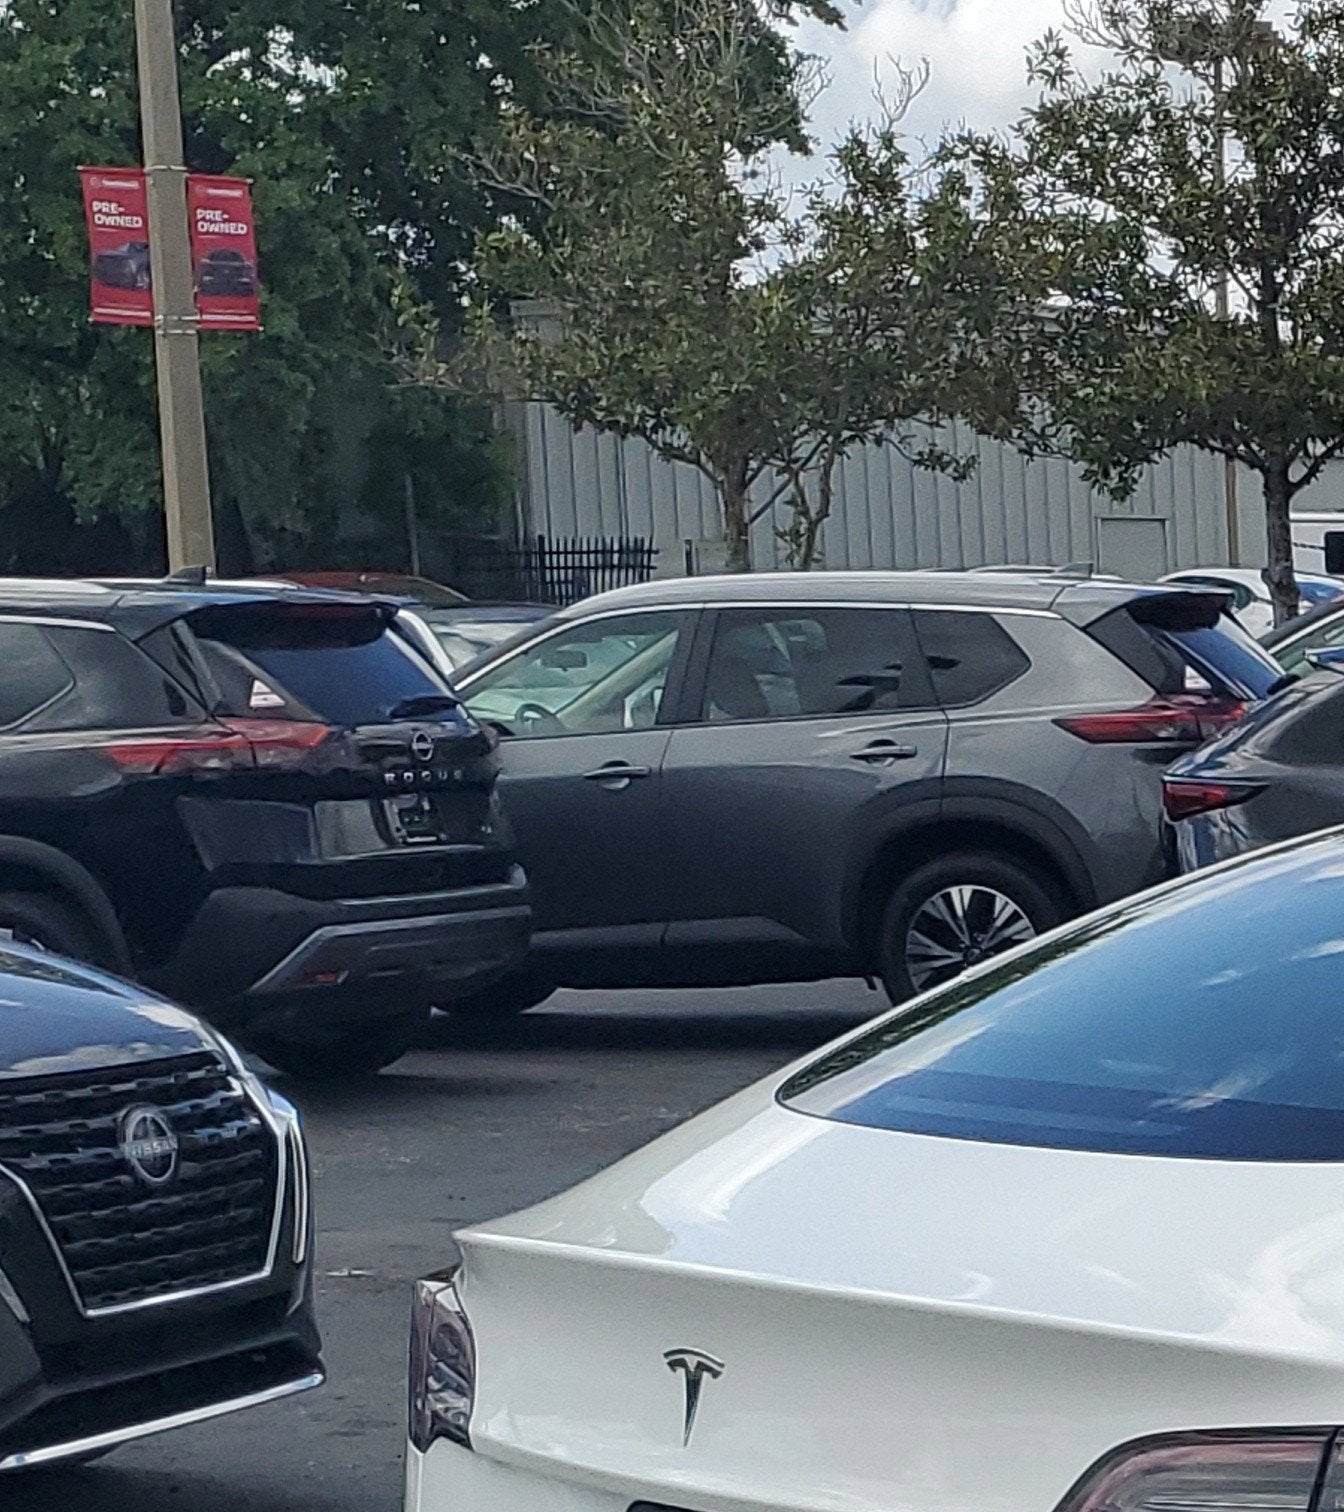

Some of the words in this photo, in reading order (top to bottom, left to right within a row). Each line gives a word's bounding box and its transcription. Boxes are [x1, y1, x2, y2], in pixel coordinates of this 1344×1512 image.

[92, 201, 126, 214] PRE-
[94, 214, 143, 228] OWNED
[196, 209, 229, 221] PRE-
[197, 221, 248, 235] OWNED
